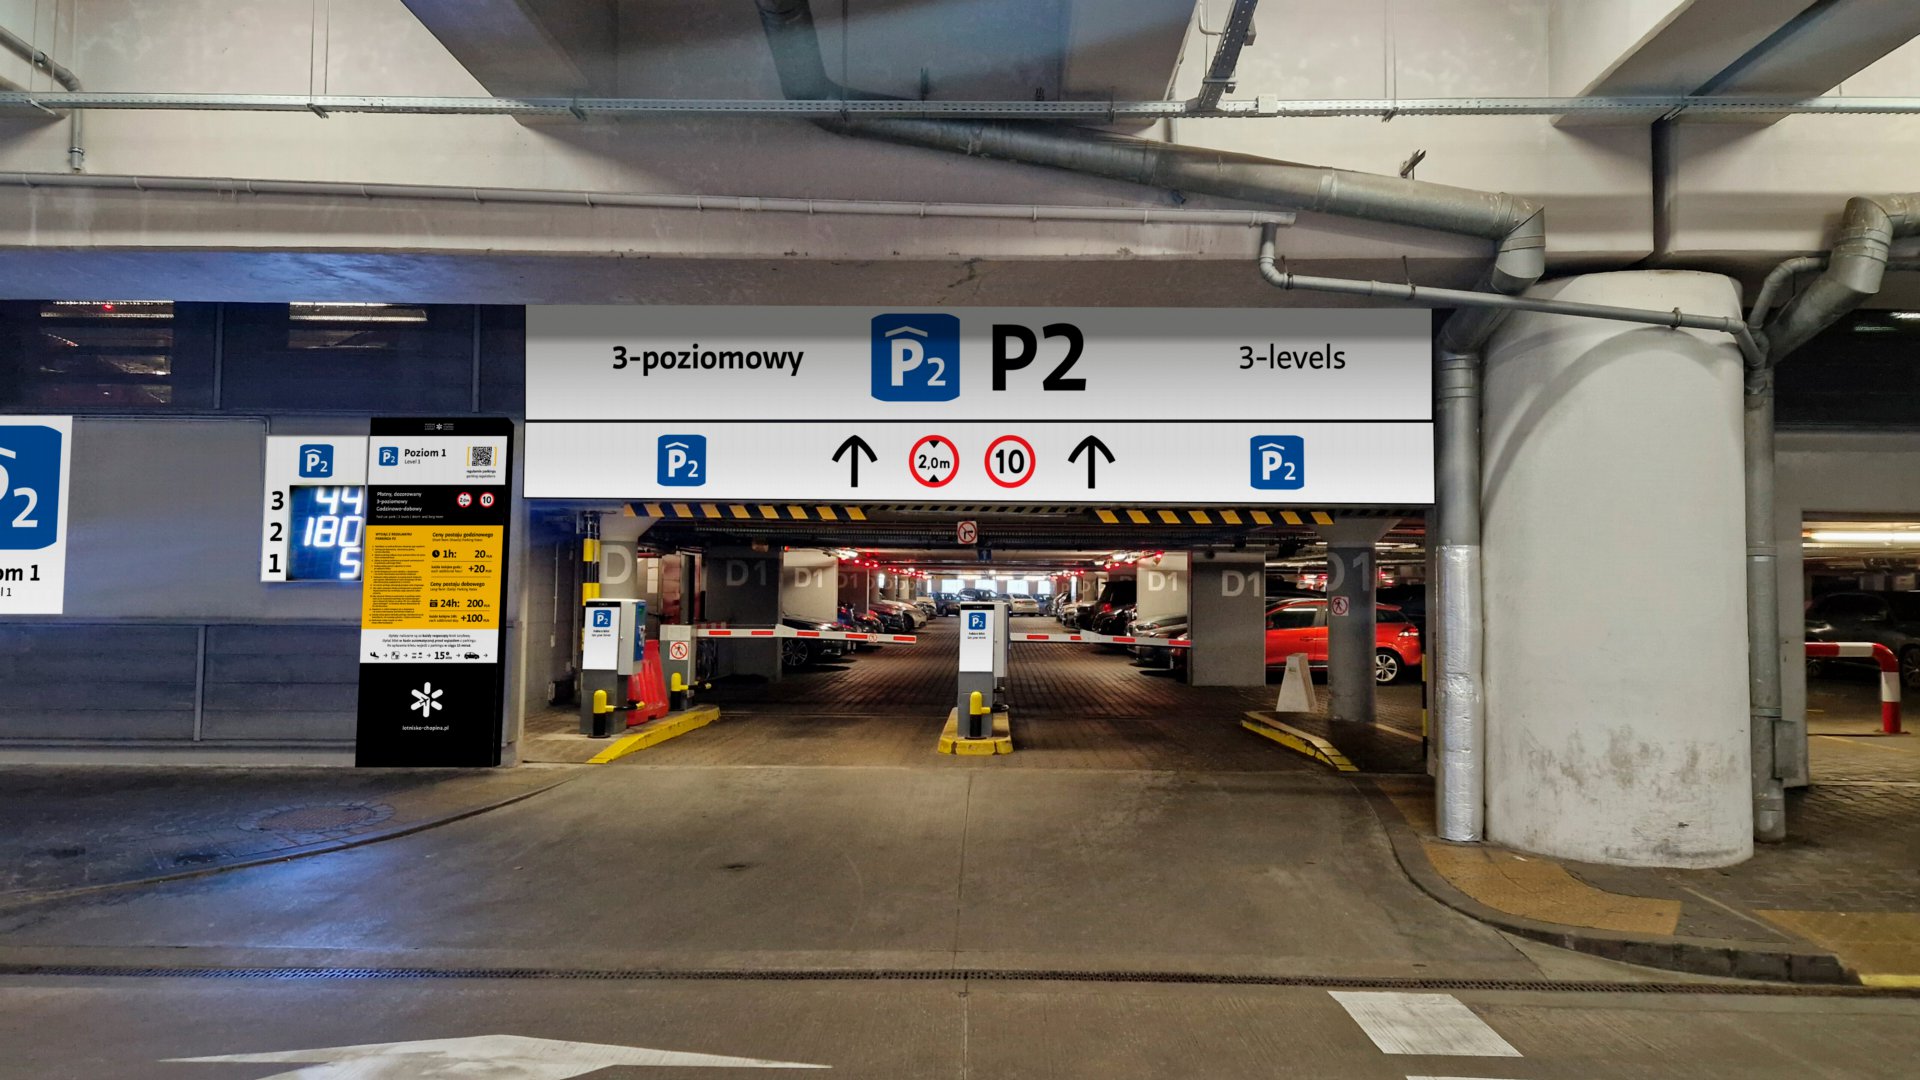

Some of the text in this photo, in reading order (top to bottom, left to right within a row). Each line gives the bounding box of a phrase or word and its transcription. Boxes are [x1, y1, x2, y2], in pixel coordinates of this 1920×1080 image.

[612, 343, 804, 376] 3-poziomowy
[991, 323, 1087, 391] P2
[1239, 343, 1346, 370] 3-levels
[404, 448, 447, 457] Poziom 1
[918, 455, 950, 470] 2,0m
[994, 449, 1025, 474] 10
[271, 490, 284, 511] 3
[316, 486, 364, 515] 44
[482, 496, 492, 504] 10
[269, 521, 283, 542] 2
[303, 515, 363, 548] 180
[268, 553, 281, 573] 1
[339, 546, 361, 579] 5
[442, 549, 457, 558] 1h:
[474, 550, 486, 558] 20
[30, 564, 40, 581] 1
[468, 564, 485, 573] +20
[726, 559, 768, 587] D1
[794, 567, 823, 588] D1
[6, 587, 12, 597] 1
[1147, 572, 1179, 592] D1
[1220, 570, 1261, 598] D1
[440, 598, 460, 608] 24h:
[466, 599, 484, 608] 200
[461, 614, 483, 623] +100
[434, 651, 446, 660] 15
